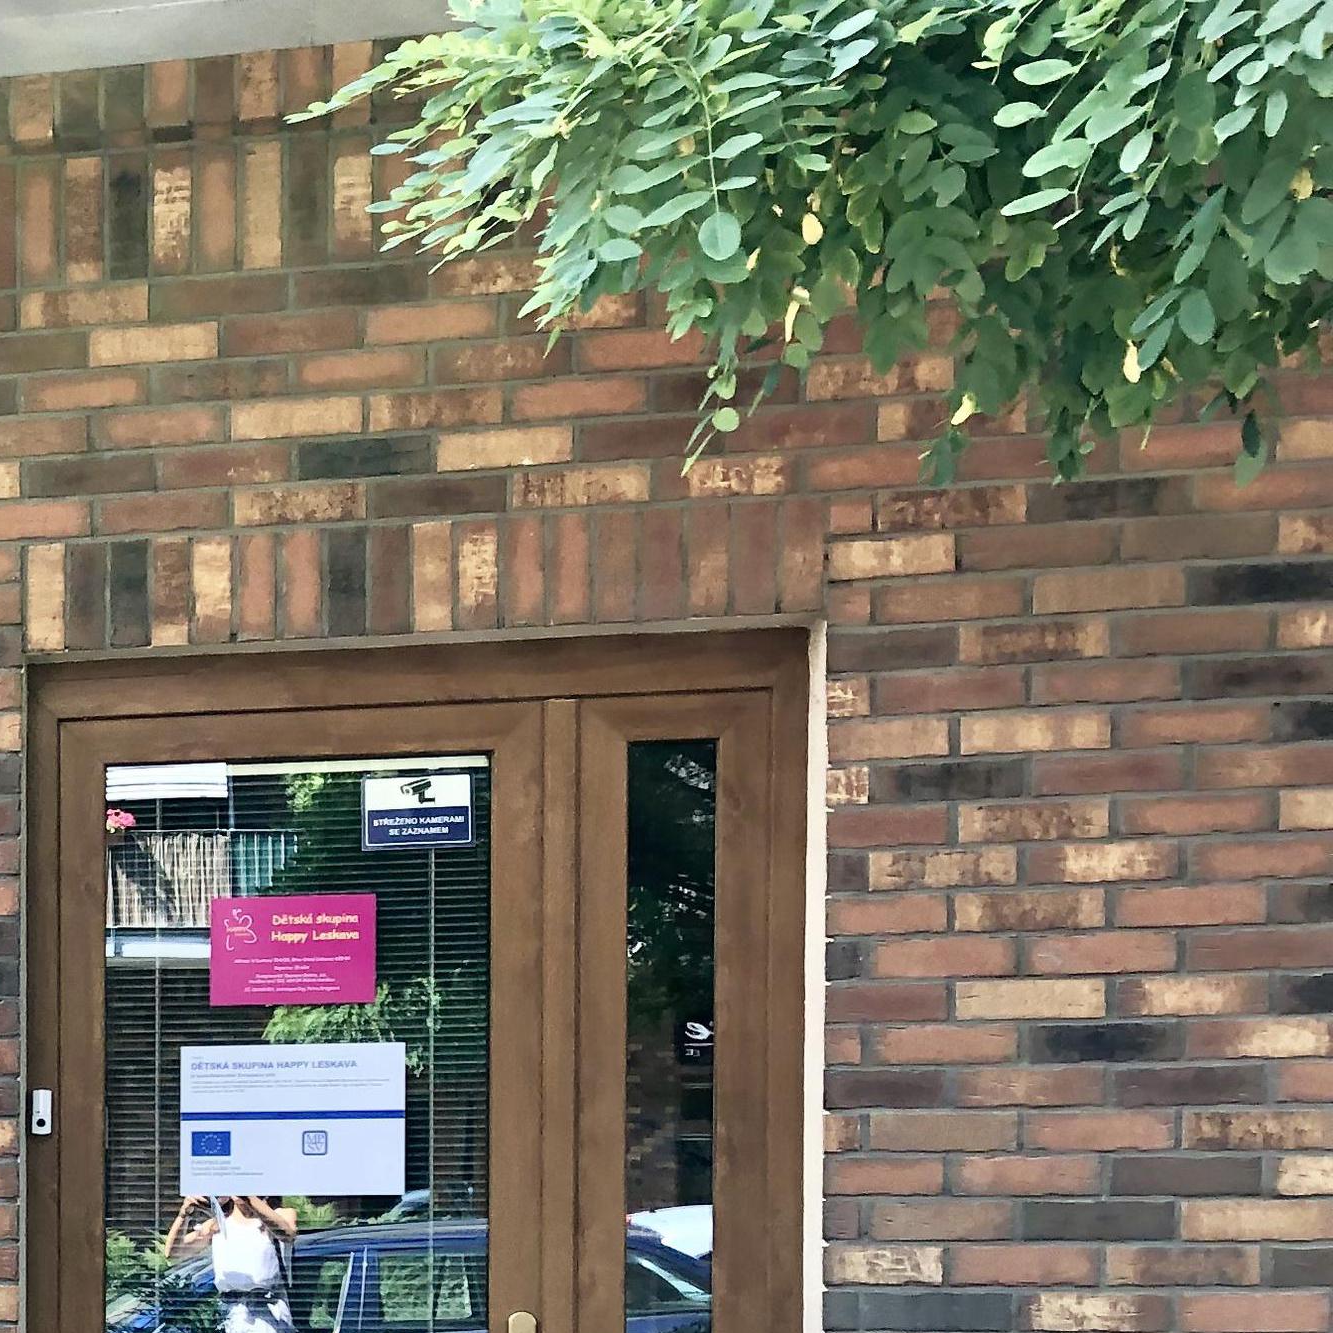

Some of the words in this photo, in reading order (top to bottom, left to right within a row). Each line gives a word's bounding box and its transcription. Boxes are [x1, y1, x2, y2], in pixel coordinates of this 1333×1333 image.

[316, 912, 359, 928] skupina
[271, 930, 309, 944] Happy
[312, 928, 360, 941] Leskava
[232, 1061, 275, 1070] SKUPINA
[276, 1060, 309, 1069] HAPPY
[311, 1059, 358, 1069] LESKAVA
